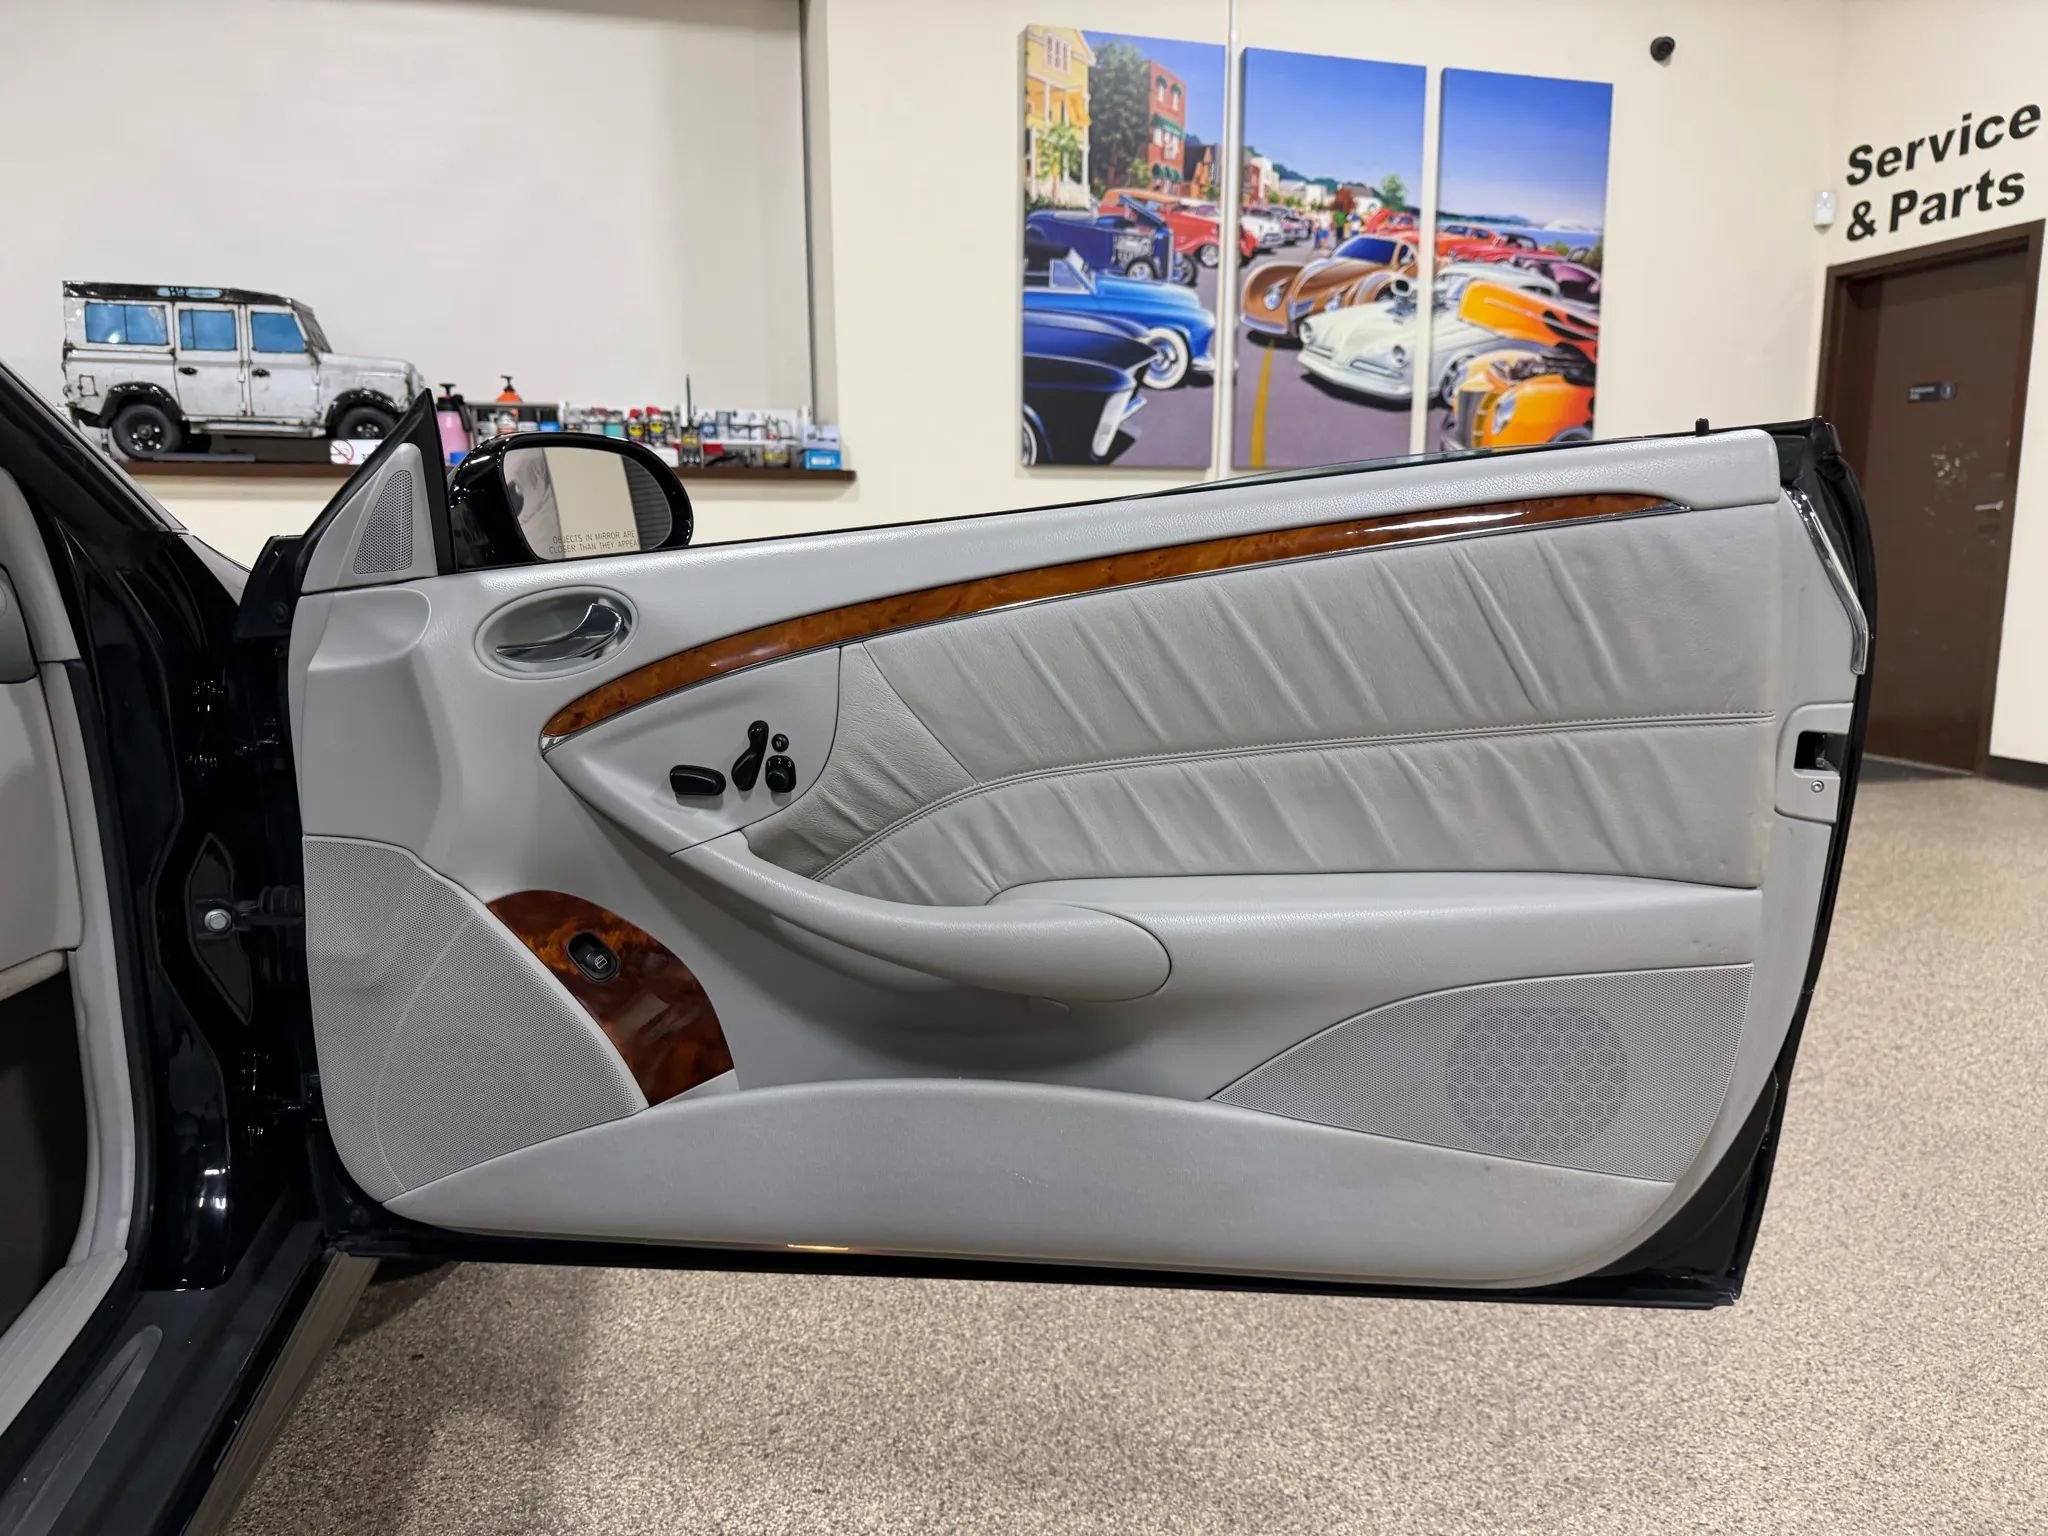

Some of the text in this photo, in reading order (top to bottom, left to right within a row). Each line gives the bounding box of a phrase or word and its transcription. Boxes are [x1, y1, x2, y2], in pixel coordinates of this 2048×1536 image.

[1846, 103, 2041, 186] Service
[1846, 168, 2025, 242] & Parts
[549, 539, 640, 554] CLOSER THAN THEY APPEA
[552, 530, 635, 545] OBJECTS IN MIRROR ARE
